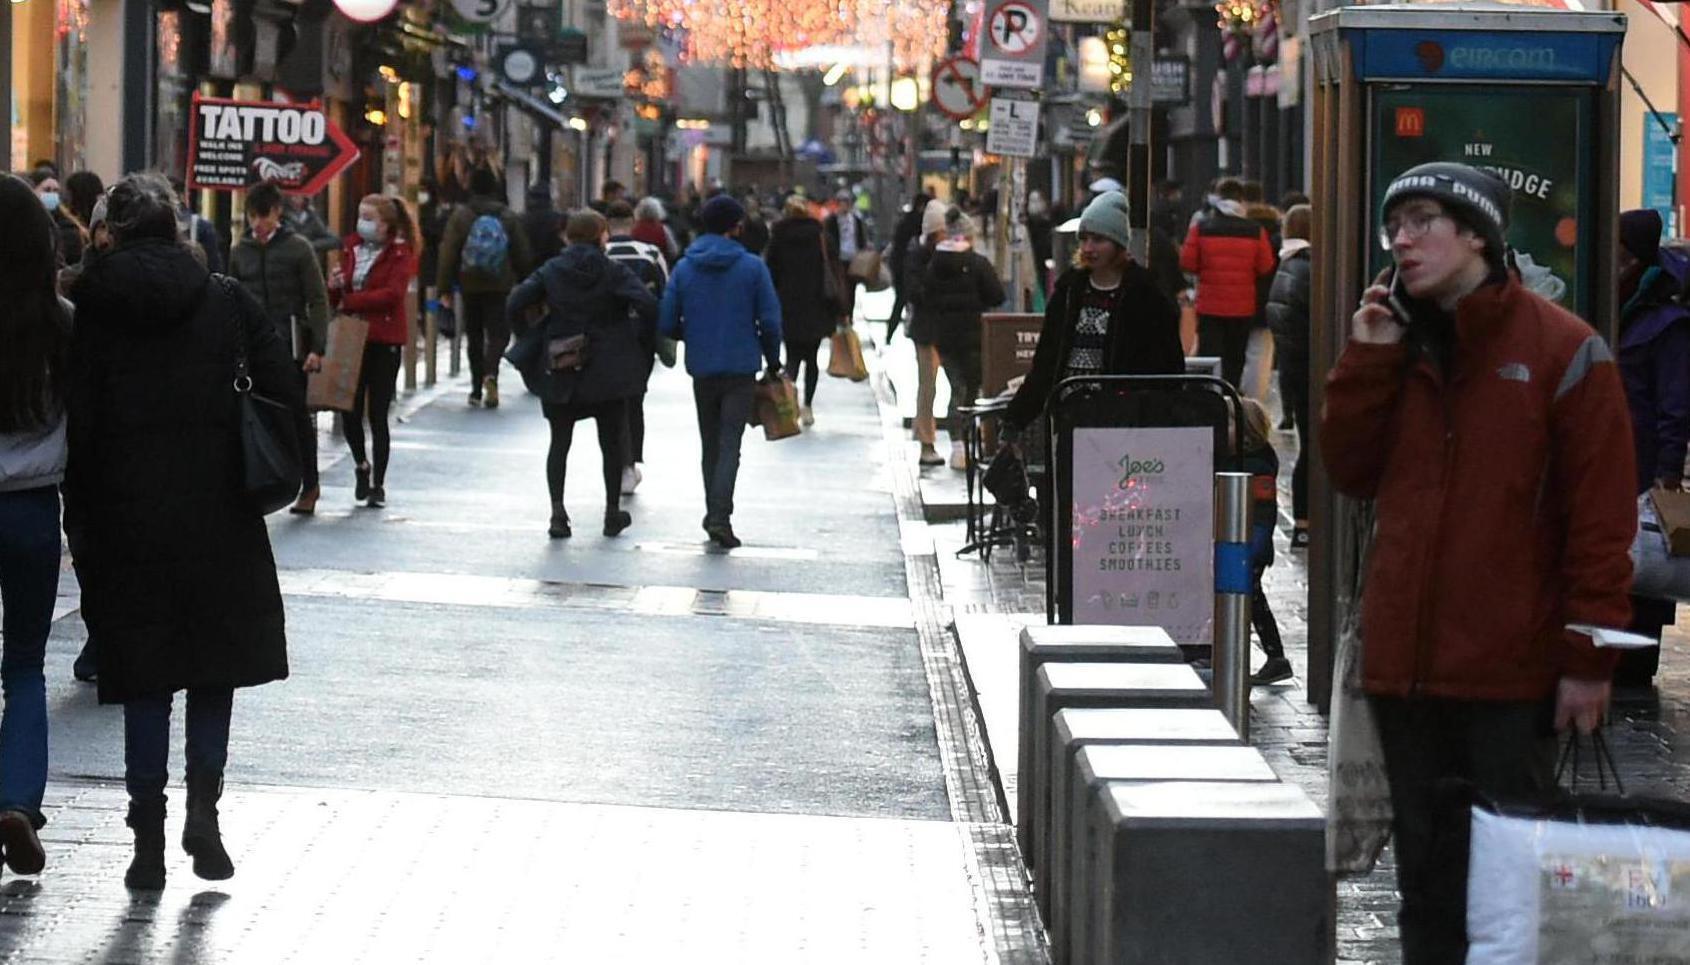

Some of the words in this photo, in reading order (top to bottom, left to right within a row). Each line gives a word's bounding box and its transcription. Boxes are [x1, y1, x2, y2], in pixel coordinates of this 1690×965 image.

[1450, 46, 1555, 68] eircom
[1150, 62, 1184, 74] USH
[1010, 102, 1020, 118] L
[200, 105, 325, 145] TATTOO
[199, 151, 244, 161] WELCOME
[1465, 144, 1492, 156] NEW
[1016, 331, 1041, 343] TRY
[1118, 453, 1164, 490] Joe's
[1099, 558, 1182, 571] SMOOTHIES
